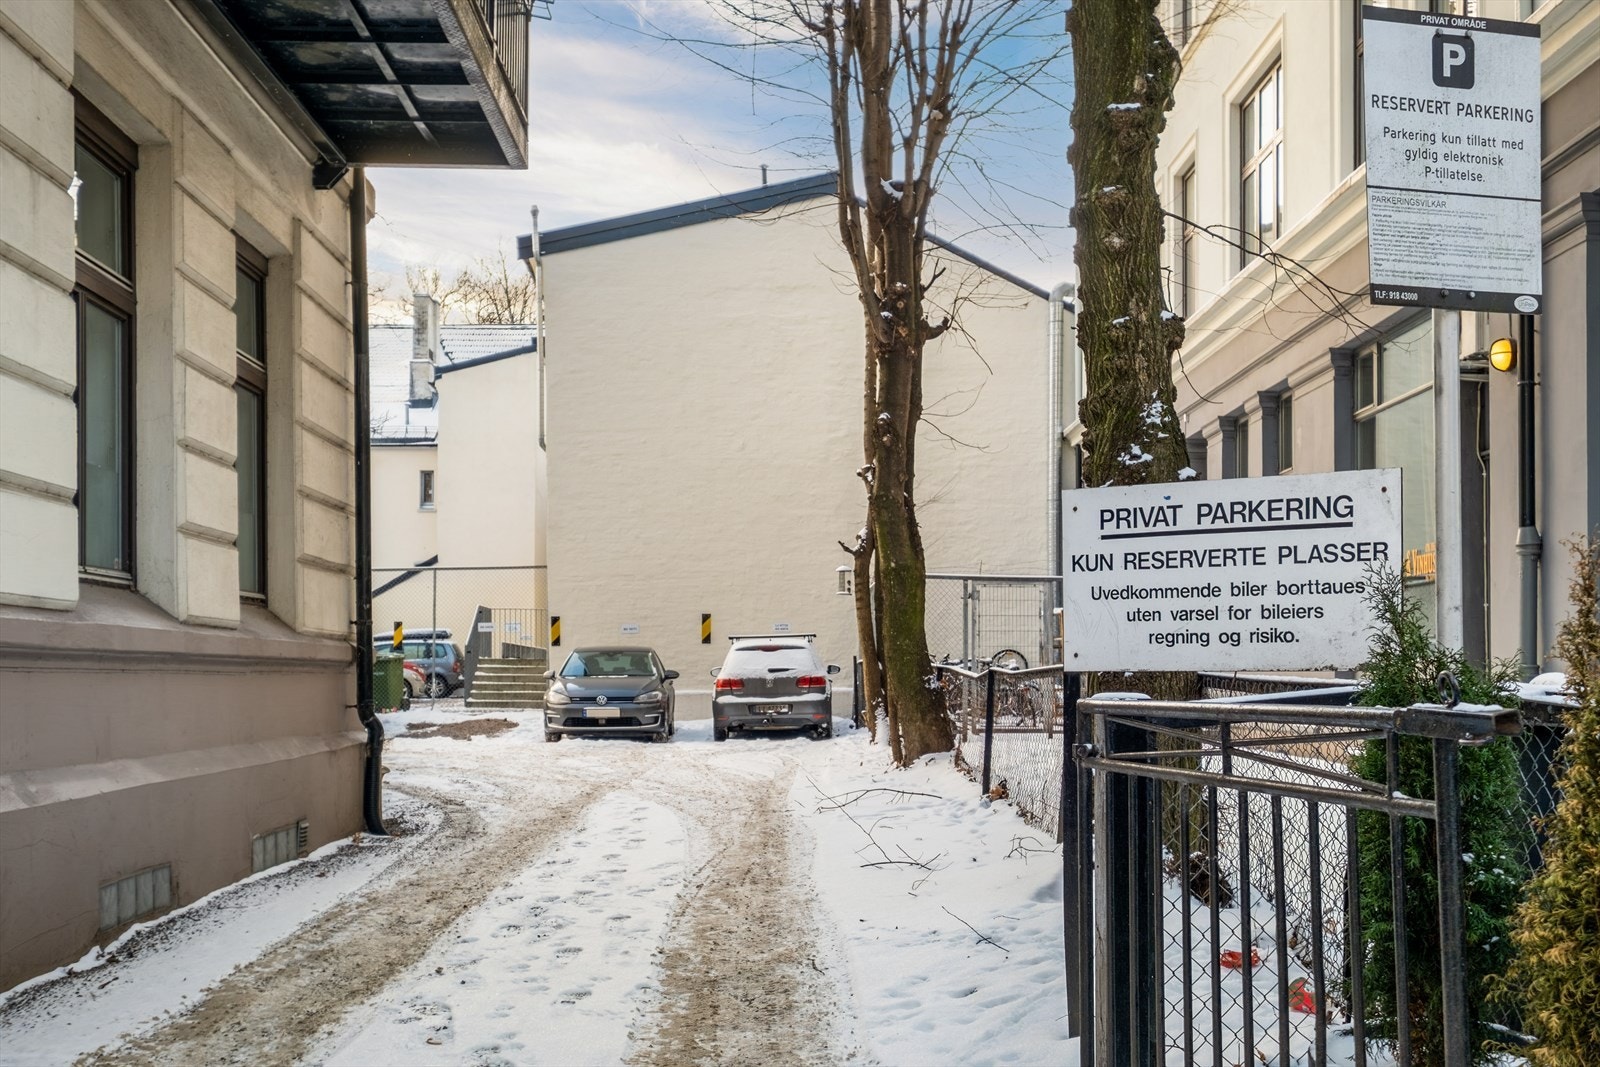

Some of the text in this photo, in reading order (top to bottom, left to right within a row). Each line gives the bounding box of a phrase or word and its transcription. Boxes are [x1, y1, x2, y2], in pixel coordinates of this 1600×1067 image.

[1420, 15, 1449, 25] PRIVAT
[1442, 43, 1466, 78] P
[1372, 94, 1534, 123] RESERVERT PARKERING
[1383, 126, 1524, 150] Parkering kun tillatt med
[1404, 148, 1504, 166] gyldig elektronisk
[1424, 166, 1486, 182] P-tillatelse.
[1100, 494, 1354, 530] PRIVAT PARKERING
[1072, 542, 1388, 572] KUN RESERVERTE PLASSER
[1091, 579, 1366, 600] Uvedkommende biler borttaues
[1126, 602, 1324, 622] uten varsel for bileiers
[1149, 628, 1300, 647] regning og risiko.
